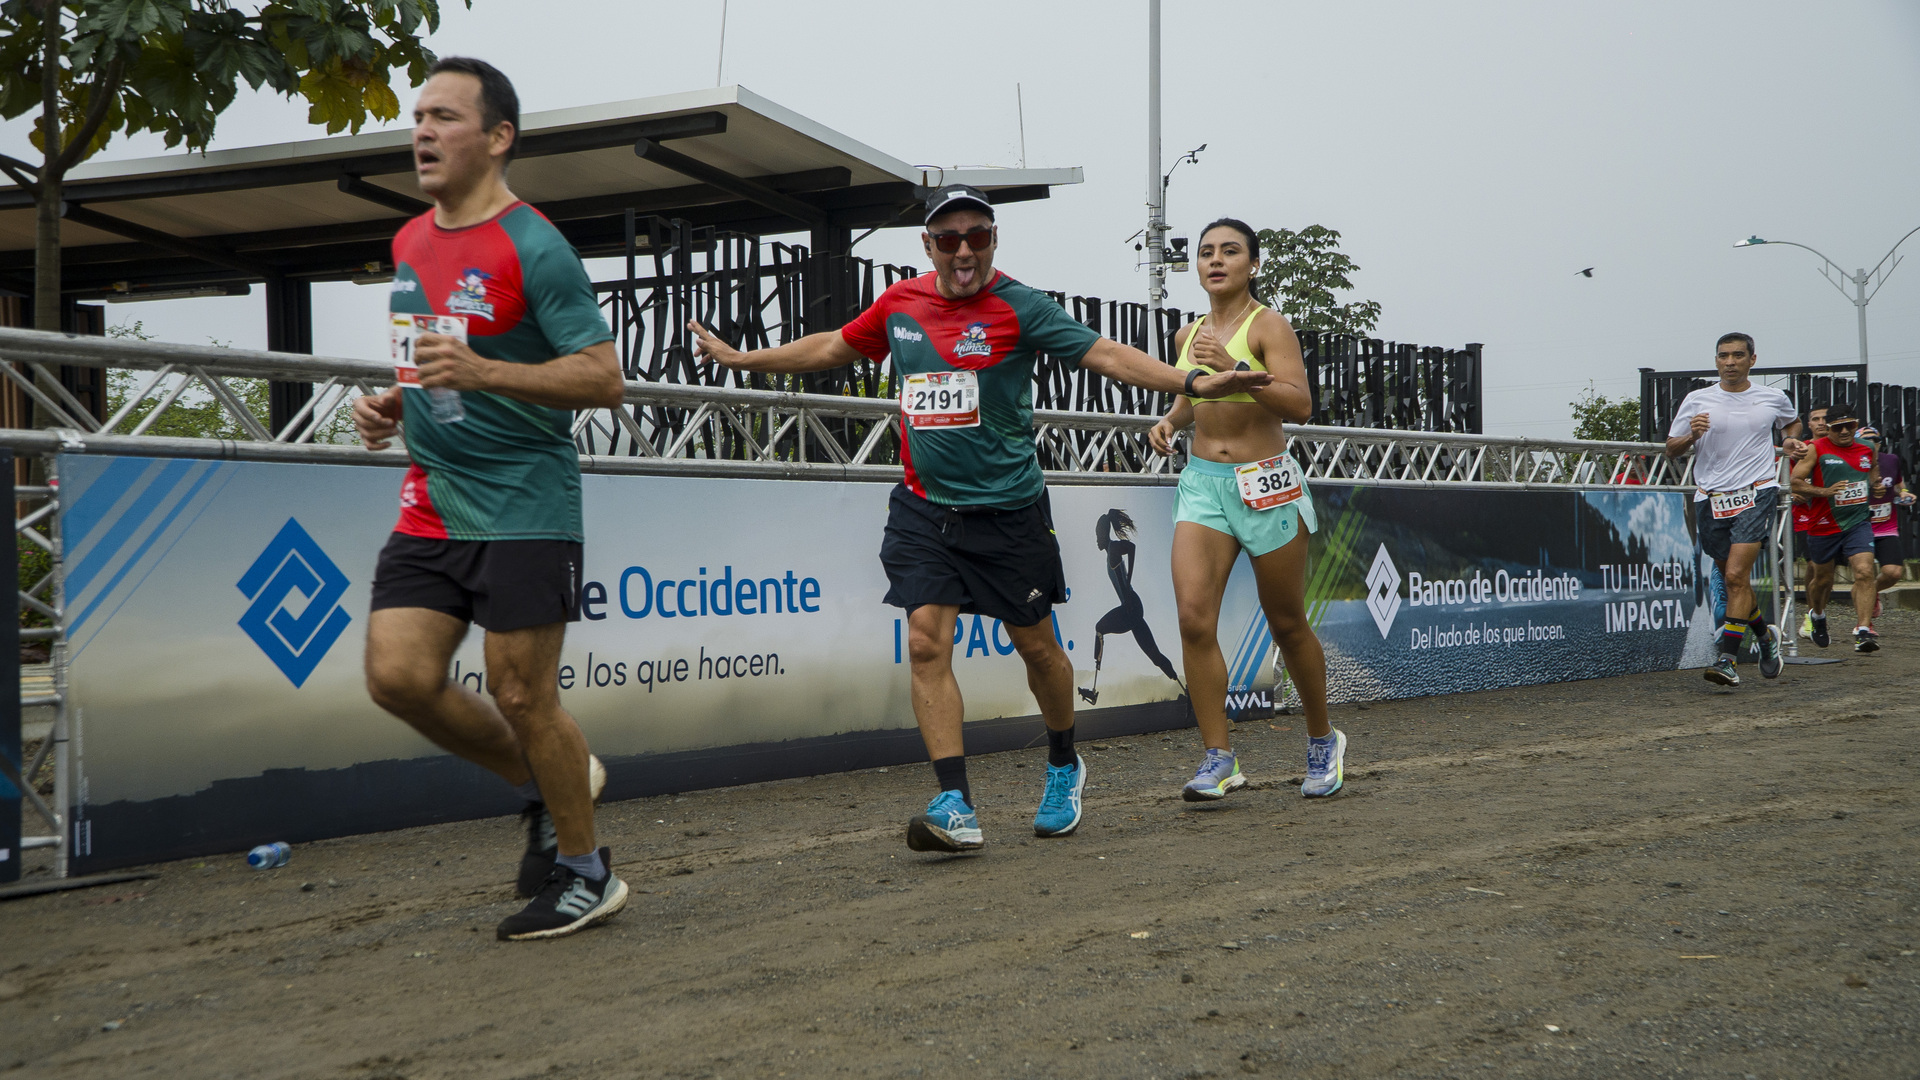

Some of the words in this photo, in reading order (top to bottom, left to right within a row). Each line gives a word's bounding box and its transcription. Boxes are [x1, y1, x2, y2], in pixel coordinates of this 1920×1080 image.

[914, 389, 963, 411] 2191
[1257, 470, 1292, 494] 382
[1844, 488, 1863, 499] 235
[1719, 494, 1750, 510] 1168
[581, 580, 608, 622] e
[619, 565, 821, 619] Occidente
[1409, 571, 1466, 607] Banco
[1469, 569, 1492, 604] de
[1495, 568, 1580, 603] Occidente
[1600, 564, 1622, 594] TU
[1628, 562, 1688, 594] HACER,
[1605, 599, 1690, 633] IMPACTA.
[1411, 625, 1432, 650] Del
[1435, 623, 1462, 648] lado
[1465, 622, 1480, 646] de
[1483, 621, 1500, 644] los
[1503, 626, 1525, 648] que
[1528, 619, 1565, 642] hacen.
[558, 664, 576, 690] e
[586, 652, 628, 688] los
[637, 655, 689, 693] que
[698, 646, 785, 681] hacen.
[1225, 690, 1272, 711] AVAL
